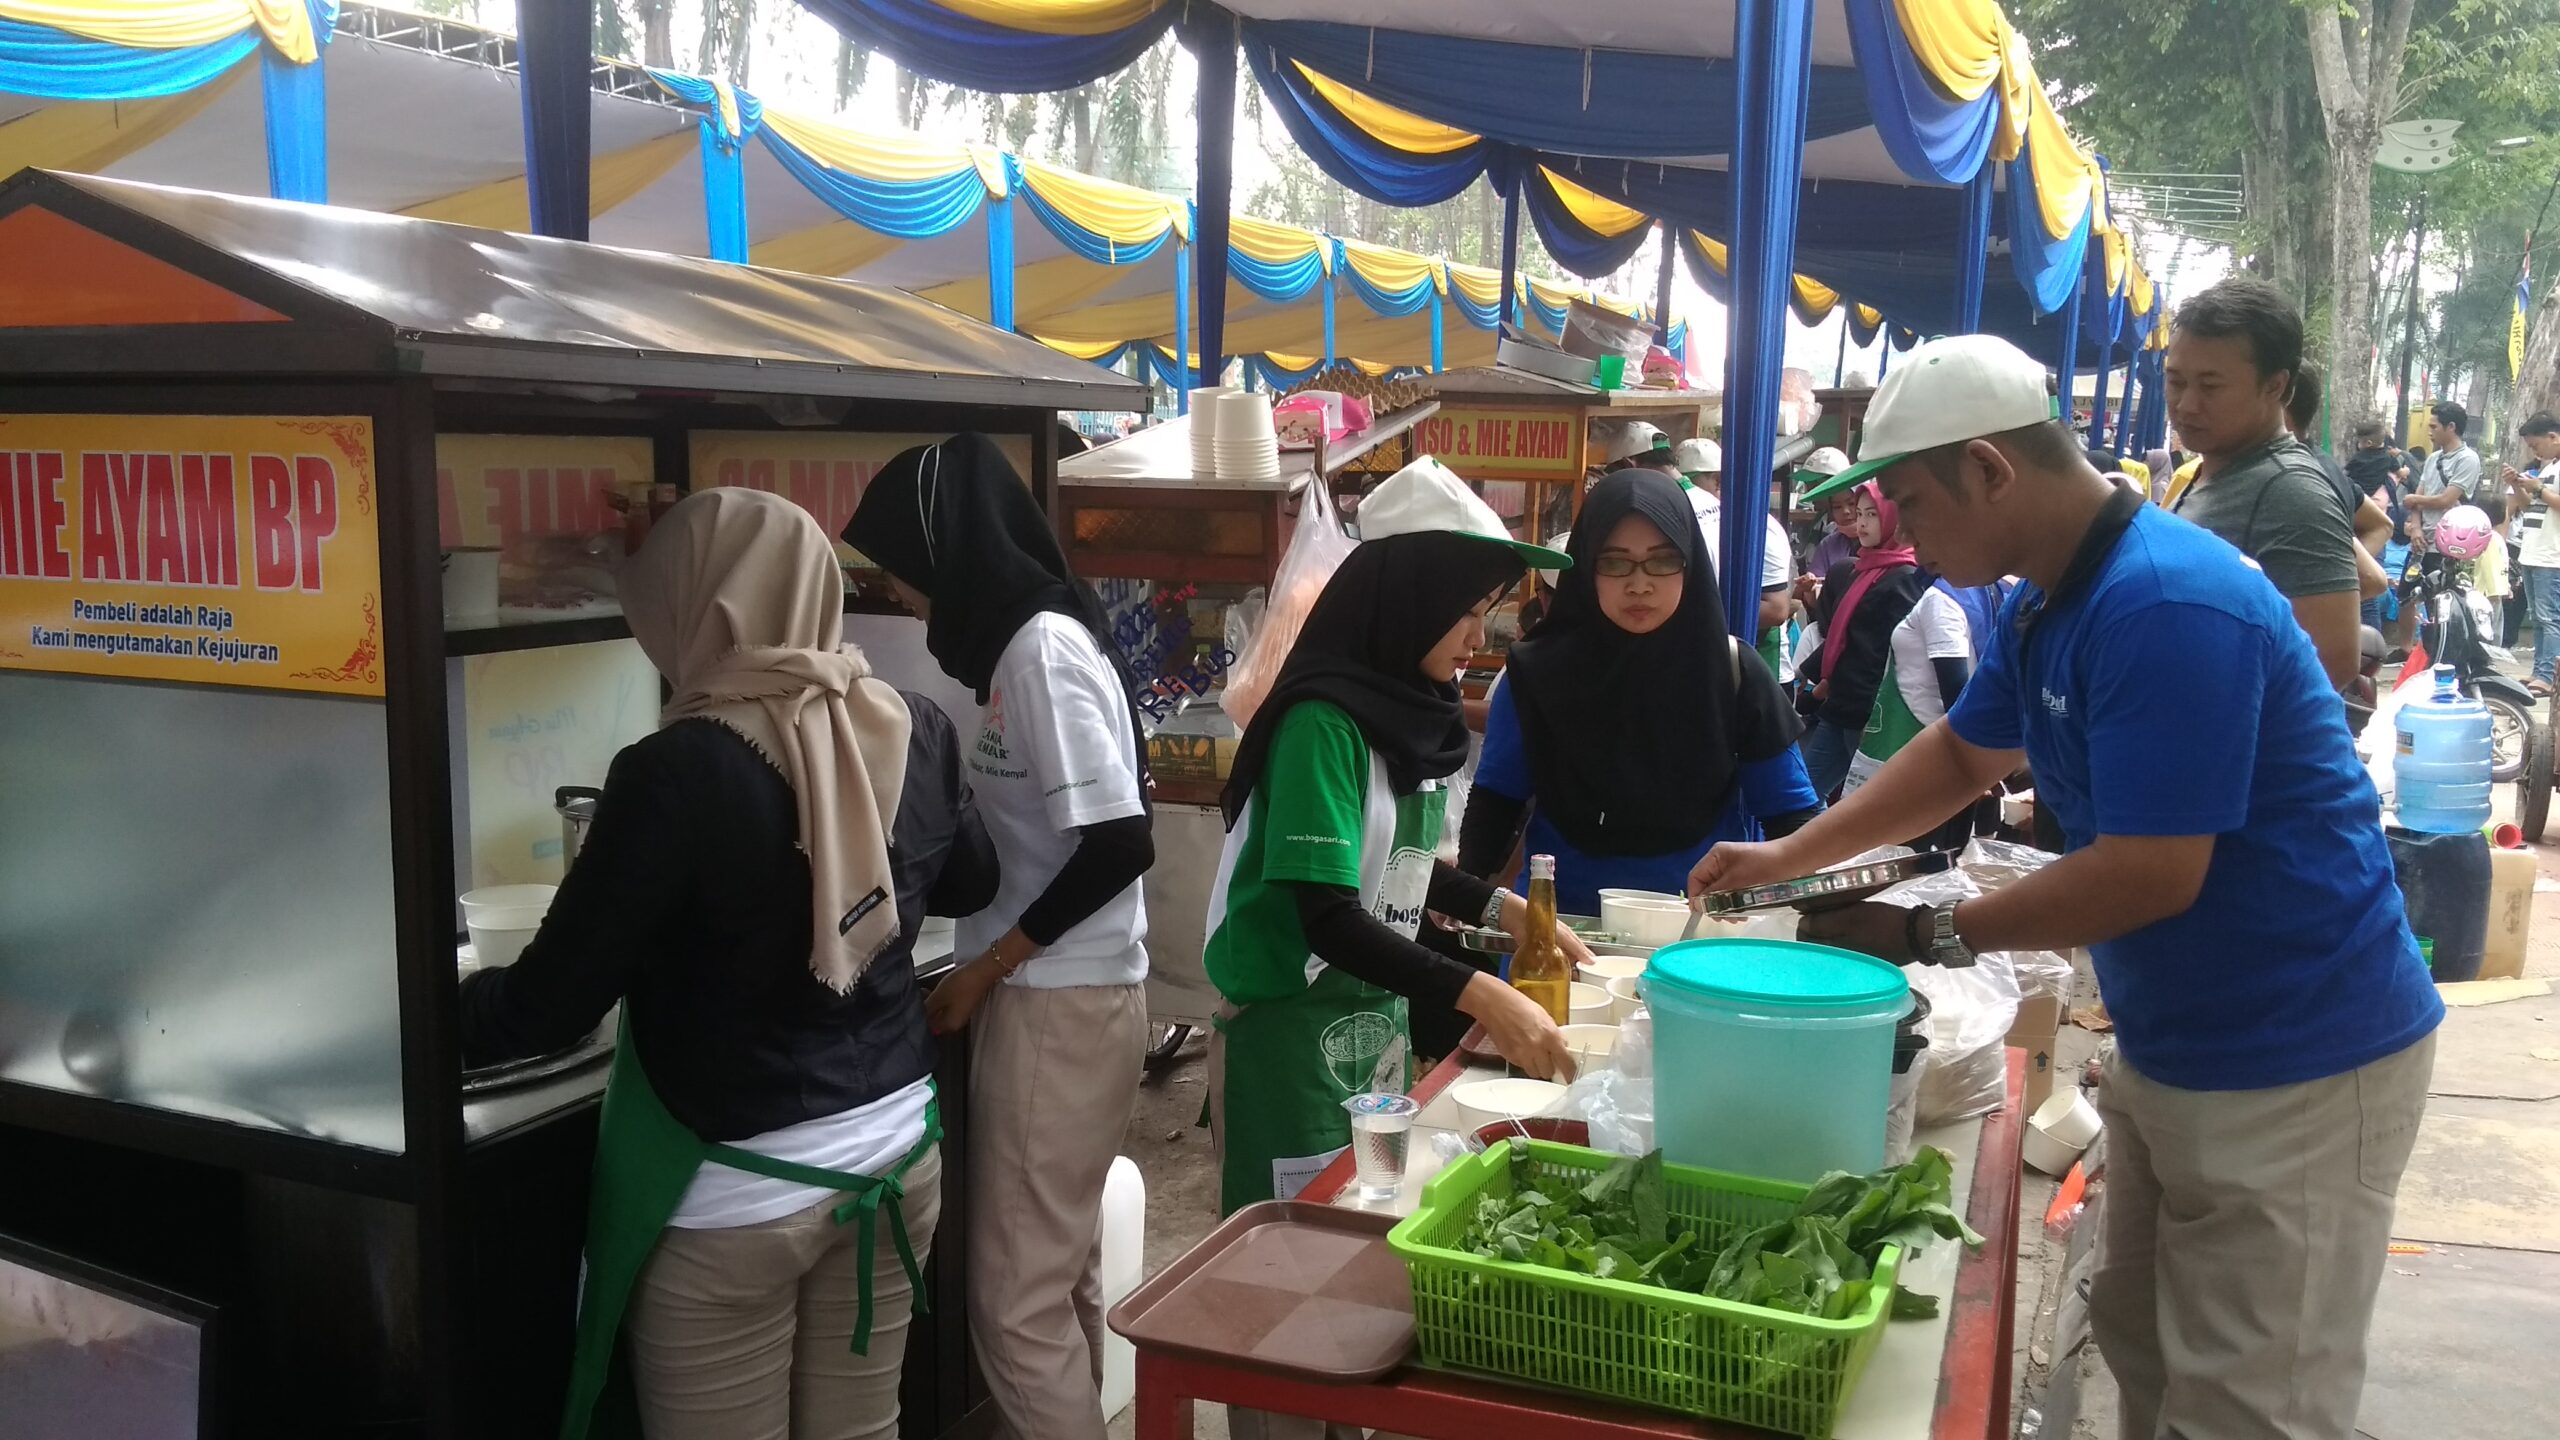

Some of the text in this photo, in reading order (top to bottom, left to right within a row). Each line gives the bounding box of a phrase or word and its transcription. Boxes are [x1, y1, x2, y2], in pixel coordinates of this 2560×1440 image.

[1415, 416, 1569, 460] KSO & MIE AYAM
[80, 452, 240, 588] AYAM
[250, 453, 337, 592] BP
[74, 599, 232, 631] Pembeli adalah Raja
[32, 626, 279, 663] Kami mengutamakan Kejujuran
[1136, 646, 1236, 724] REBUS
[1000, 767, 1028, 780] Kenyal
